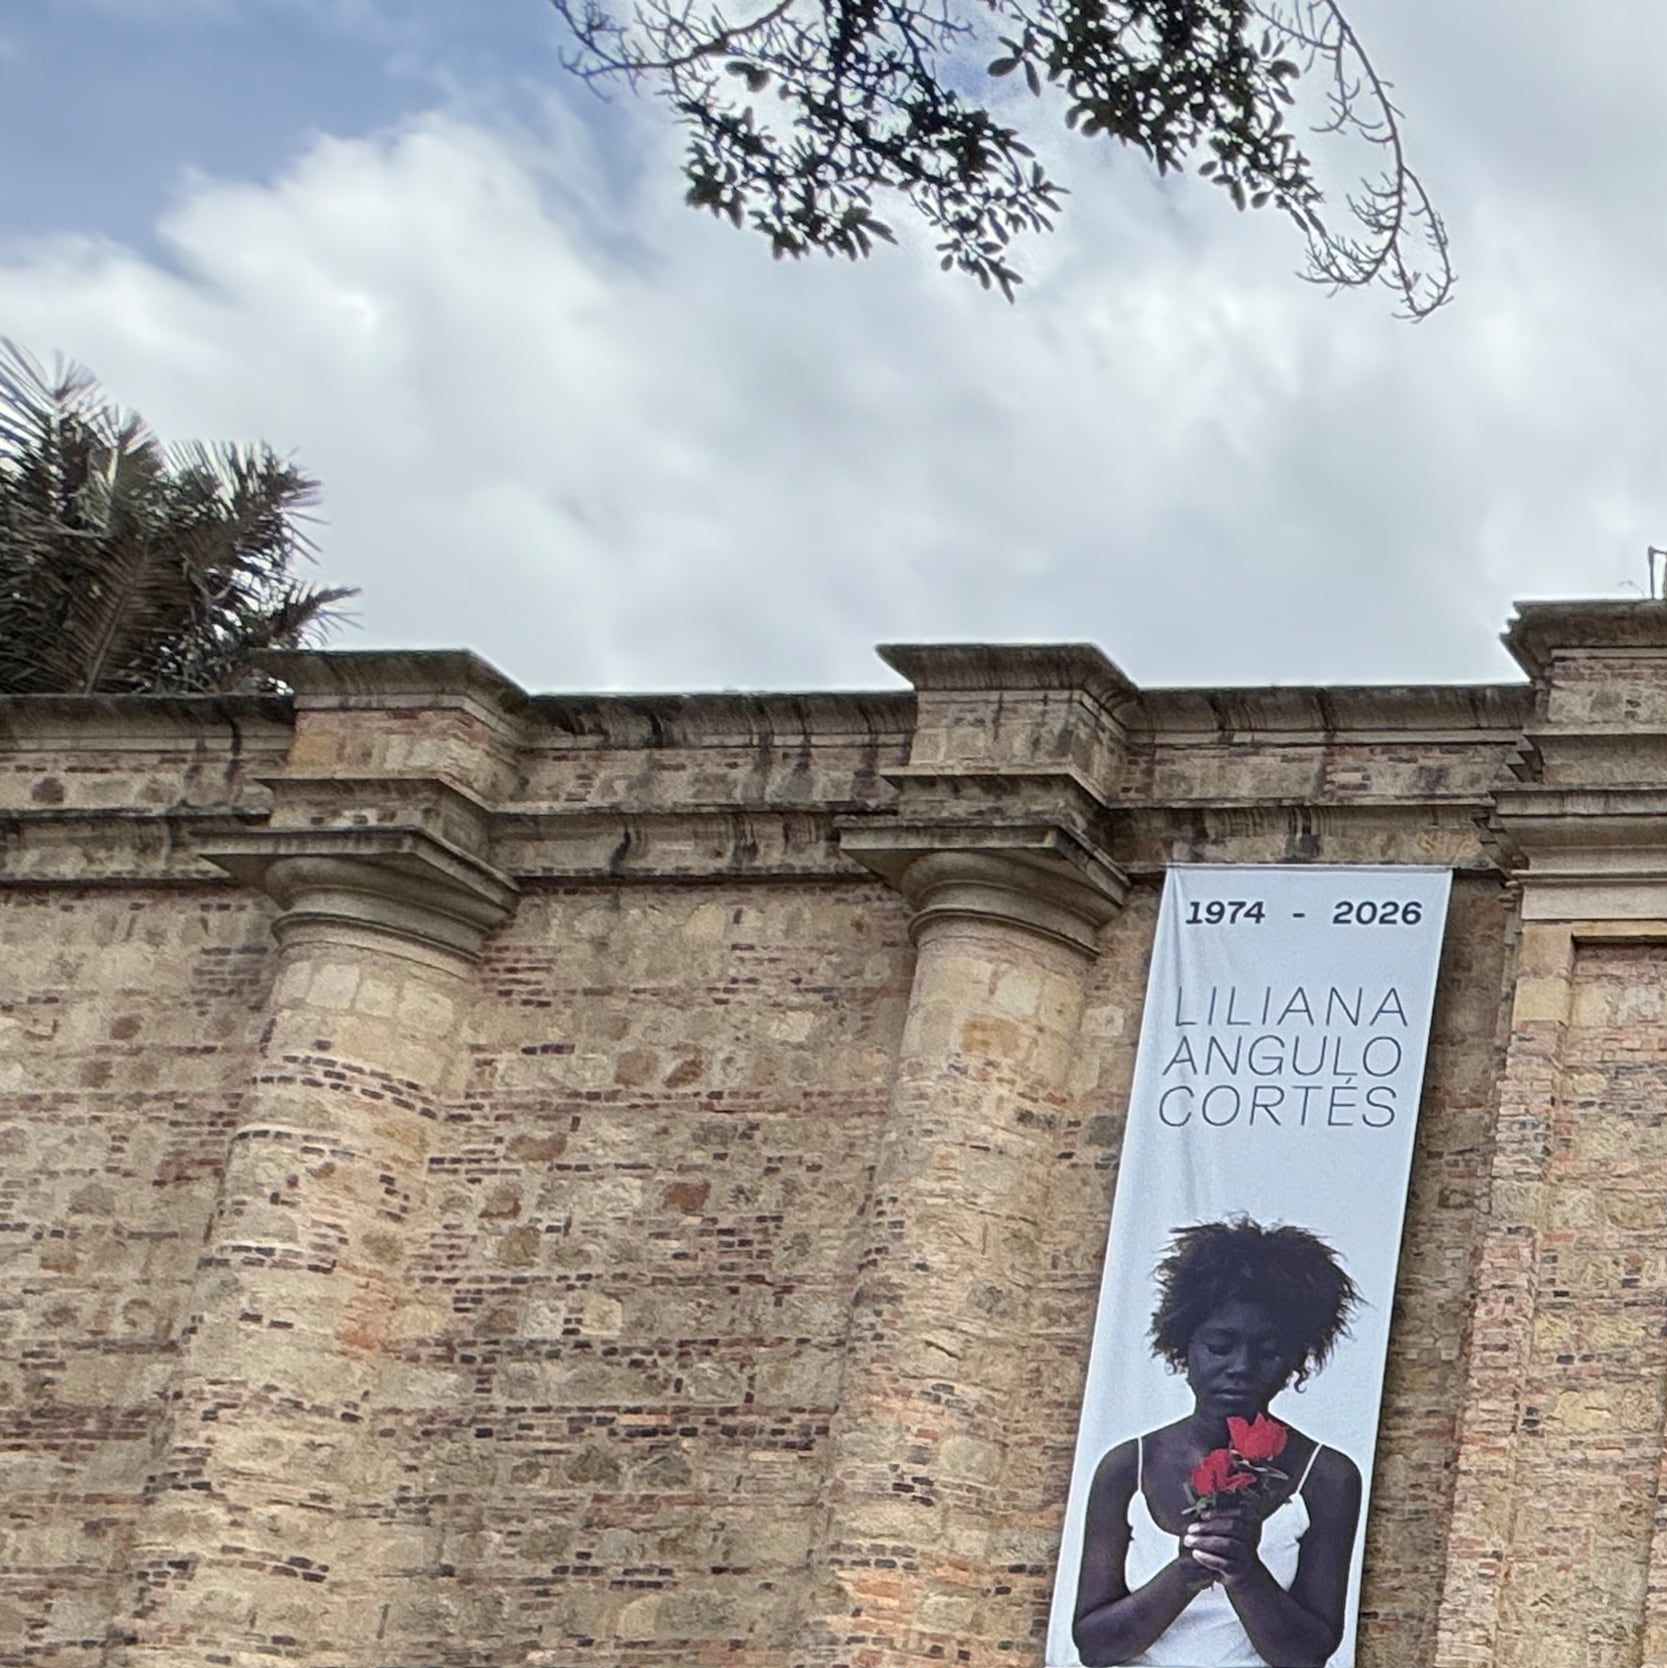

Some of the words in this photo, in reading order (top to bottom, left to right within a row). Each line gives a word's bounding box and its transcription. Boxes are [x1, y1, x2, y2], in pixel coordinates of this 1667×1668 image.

[1184, 900, 1266, 925] 1974
[1332, 900, 1423, 925] 2026
[1174, 985, 1409, 1027] LILIANA
[1162, 1034, 1402, 1077] ANGULO
[1158, 1077, 1397, 1128] CORTÉS
